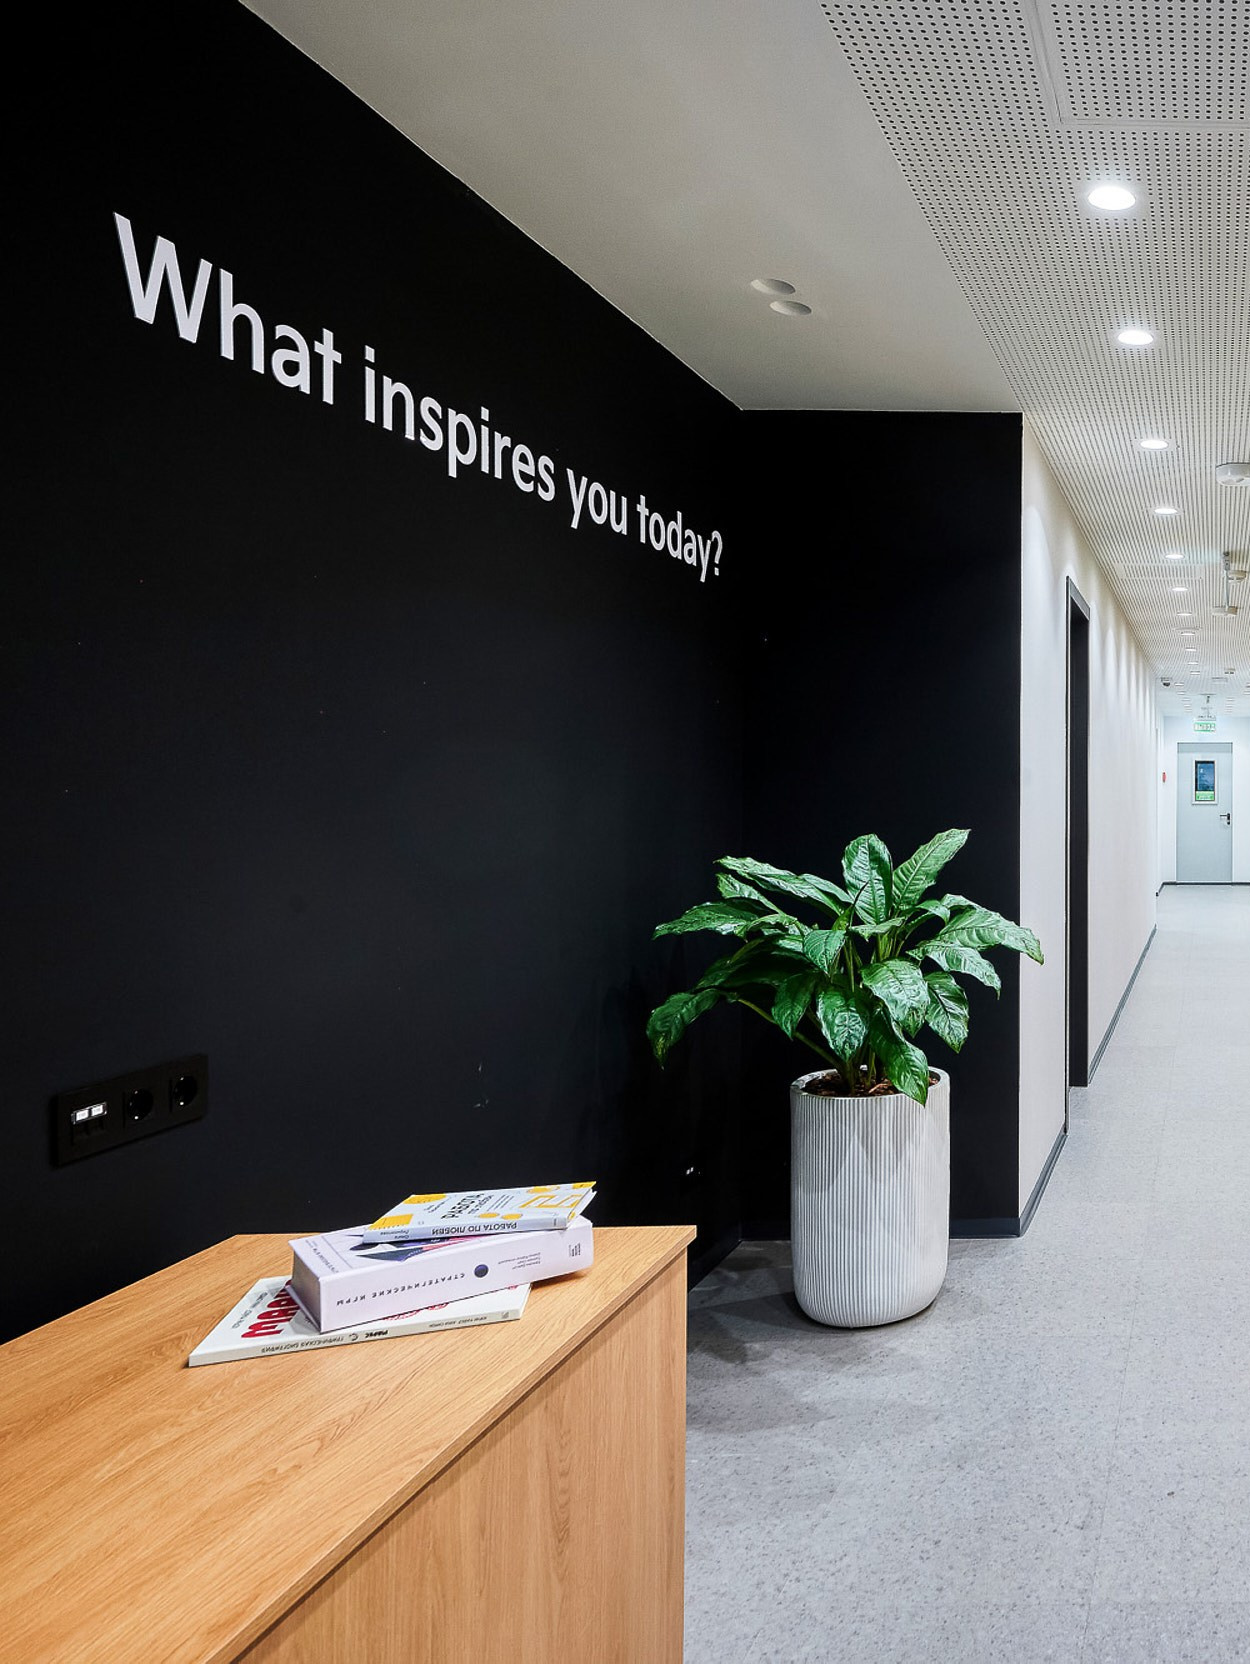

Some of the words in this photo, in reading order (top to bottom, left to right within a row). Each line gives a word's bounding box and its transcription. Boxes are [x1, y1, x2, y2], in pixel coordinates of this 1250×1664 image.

[114, 212, 341, 404] What
[365, 345, 555, 501] inspires
[567, 468, 627, 535] you
[637, 495, 722, 582] today?
[432, 1226, 466, 1236] ЛЮБВИ
[468, 1224, 480, 1233] ПО
[484, 1222, 517, 1232] РАБОТА
[372, 1272, 465, 1298] СТРАТЕГИЧЕСКИЕ
[336, 1294, 366, 1306] ИГРЫ
[241, 1280, 300, 1338] МАР
